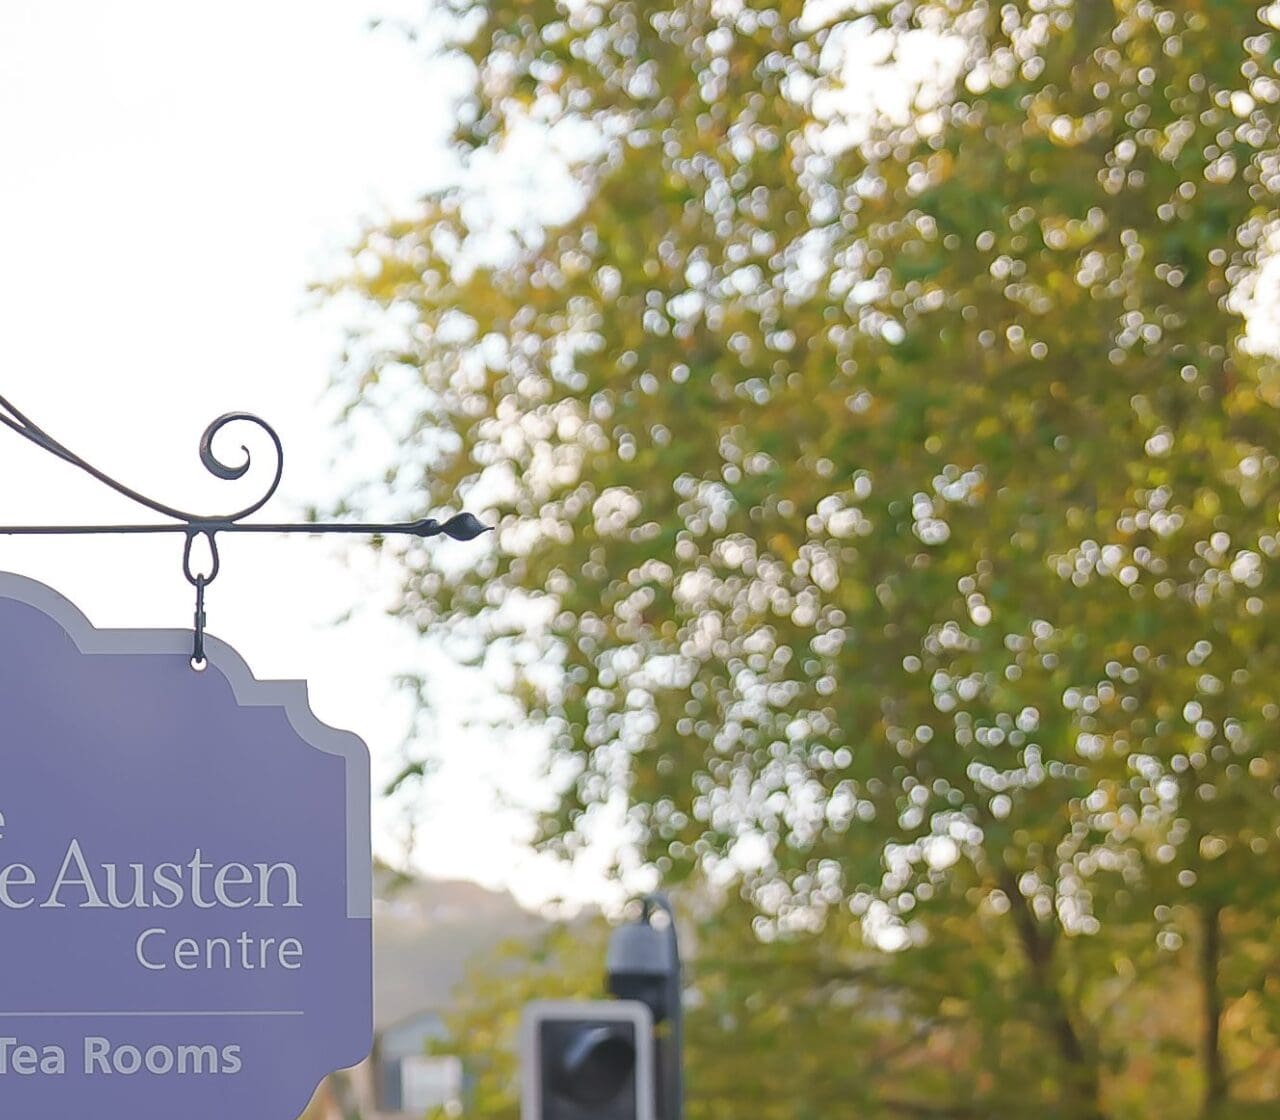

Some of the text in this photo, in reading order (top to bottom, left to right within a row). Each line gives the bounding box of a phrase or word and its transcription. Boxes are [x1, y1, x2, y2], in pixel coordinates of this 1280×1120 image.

[39, 838, 304, 909] Austen
[135, 928, 304, 970] Centre
[84, 1036, 243, 1075] Rooms
